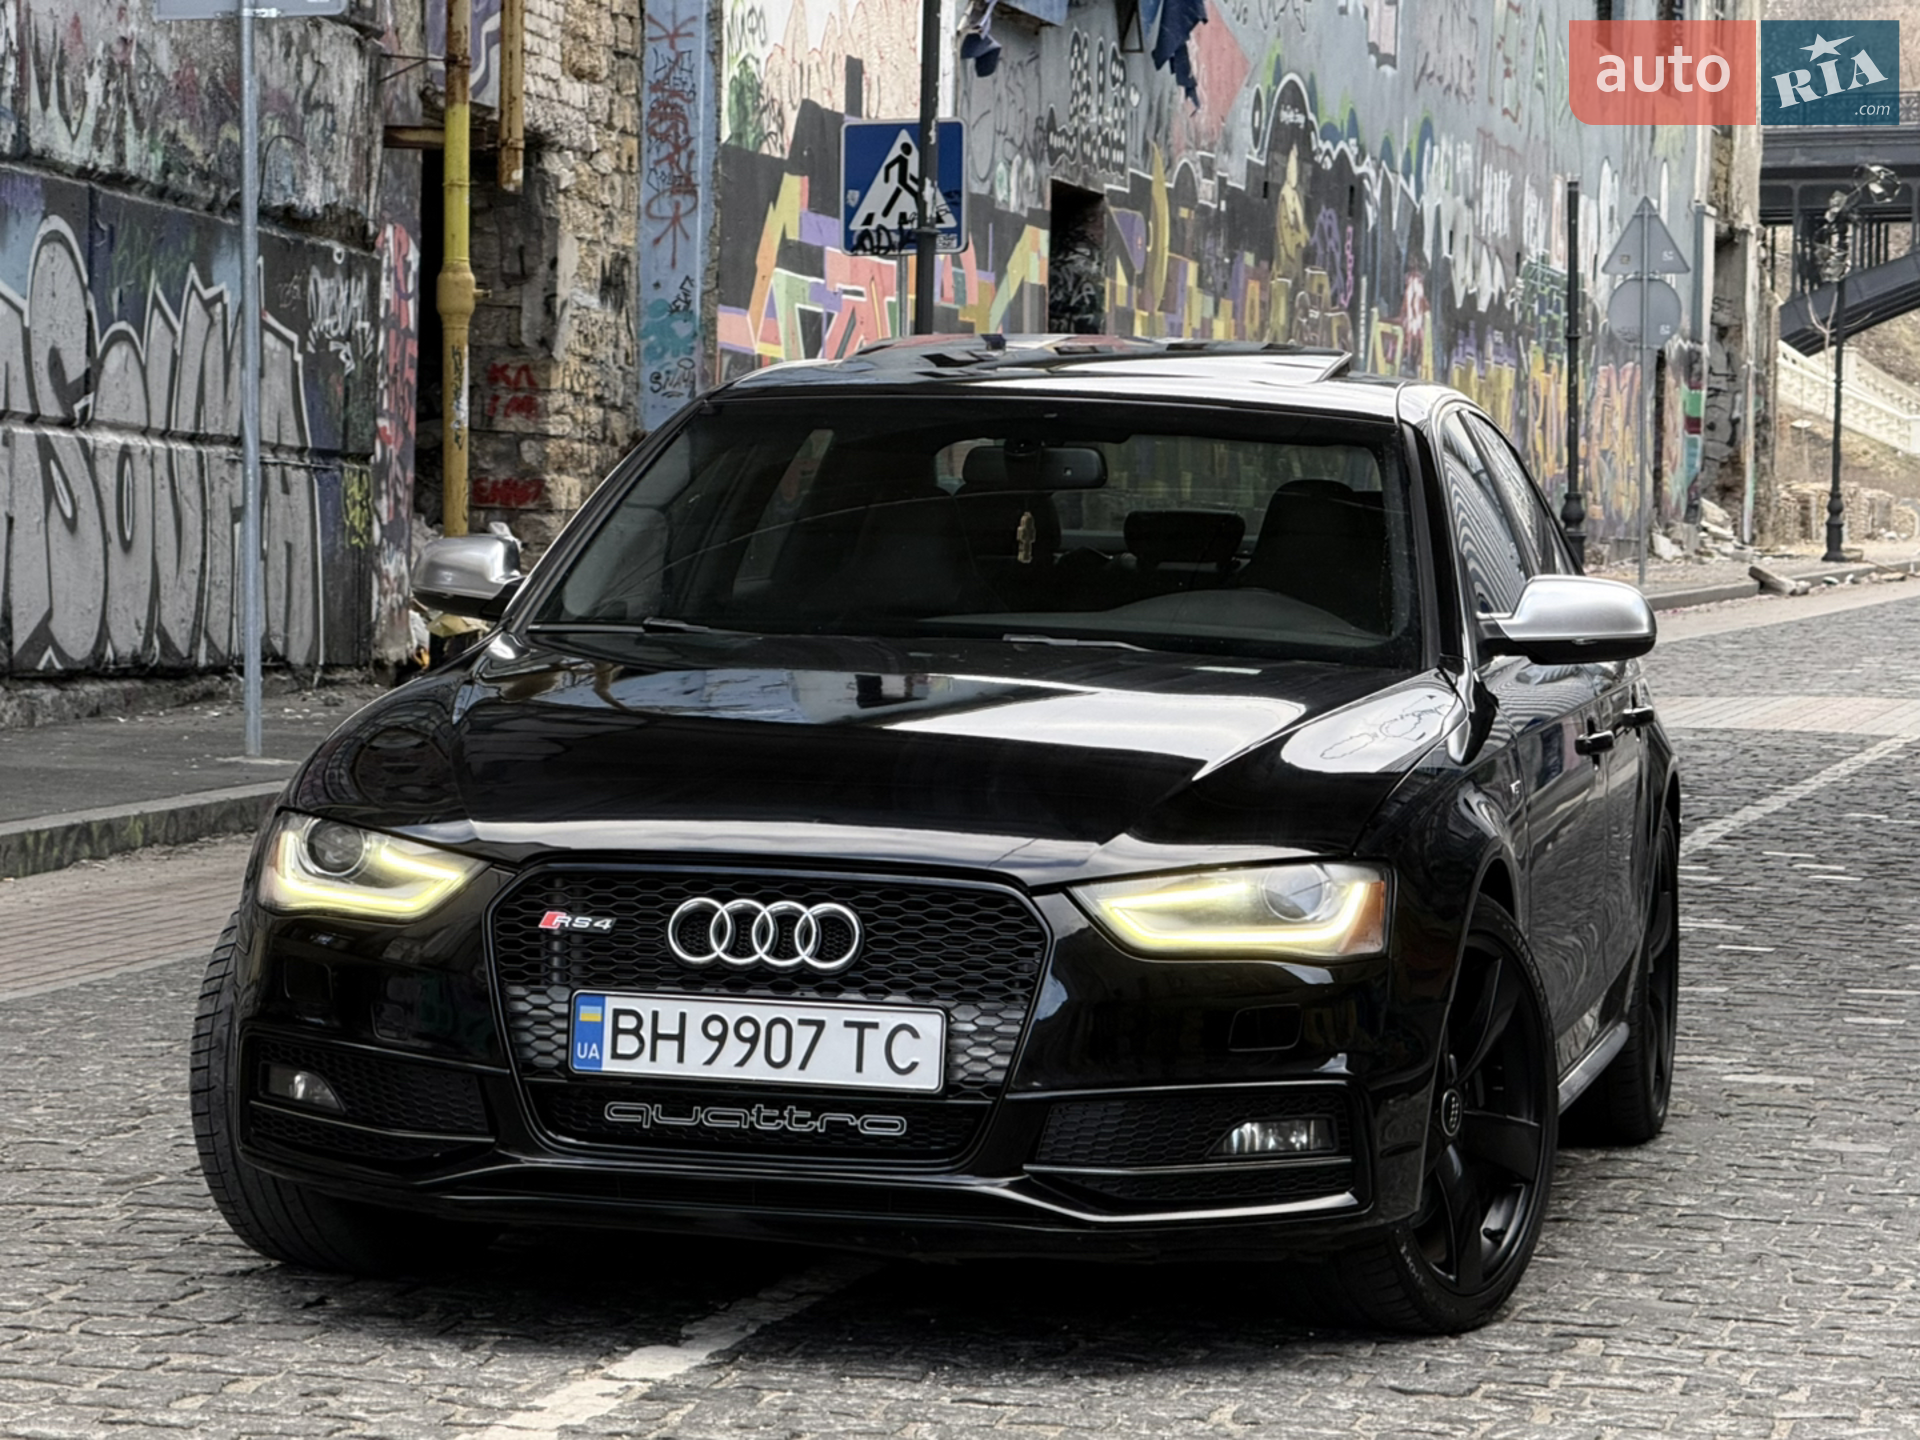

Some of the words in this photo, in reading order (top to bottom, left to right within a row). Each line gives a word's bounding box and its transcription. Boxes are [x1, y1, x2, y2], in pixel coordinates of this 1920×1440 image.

[551, 915, 613, 931] RS4
[576, 1041, 600, 1060] UA
[609, 1007, 687, 1064] BH
[701, 1013, 826, 1072] 9907
[843, 1019, 921, 1076] TC
[604, 1102, 907, 1136] quattro
